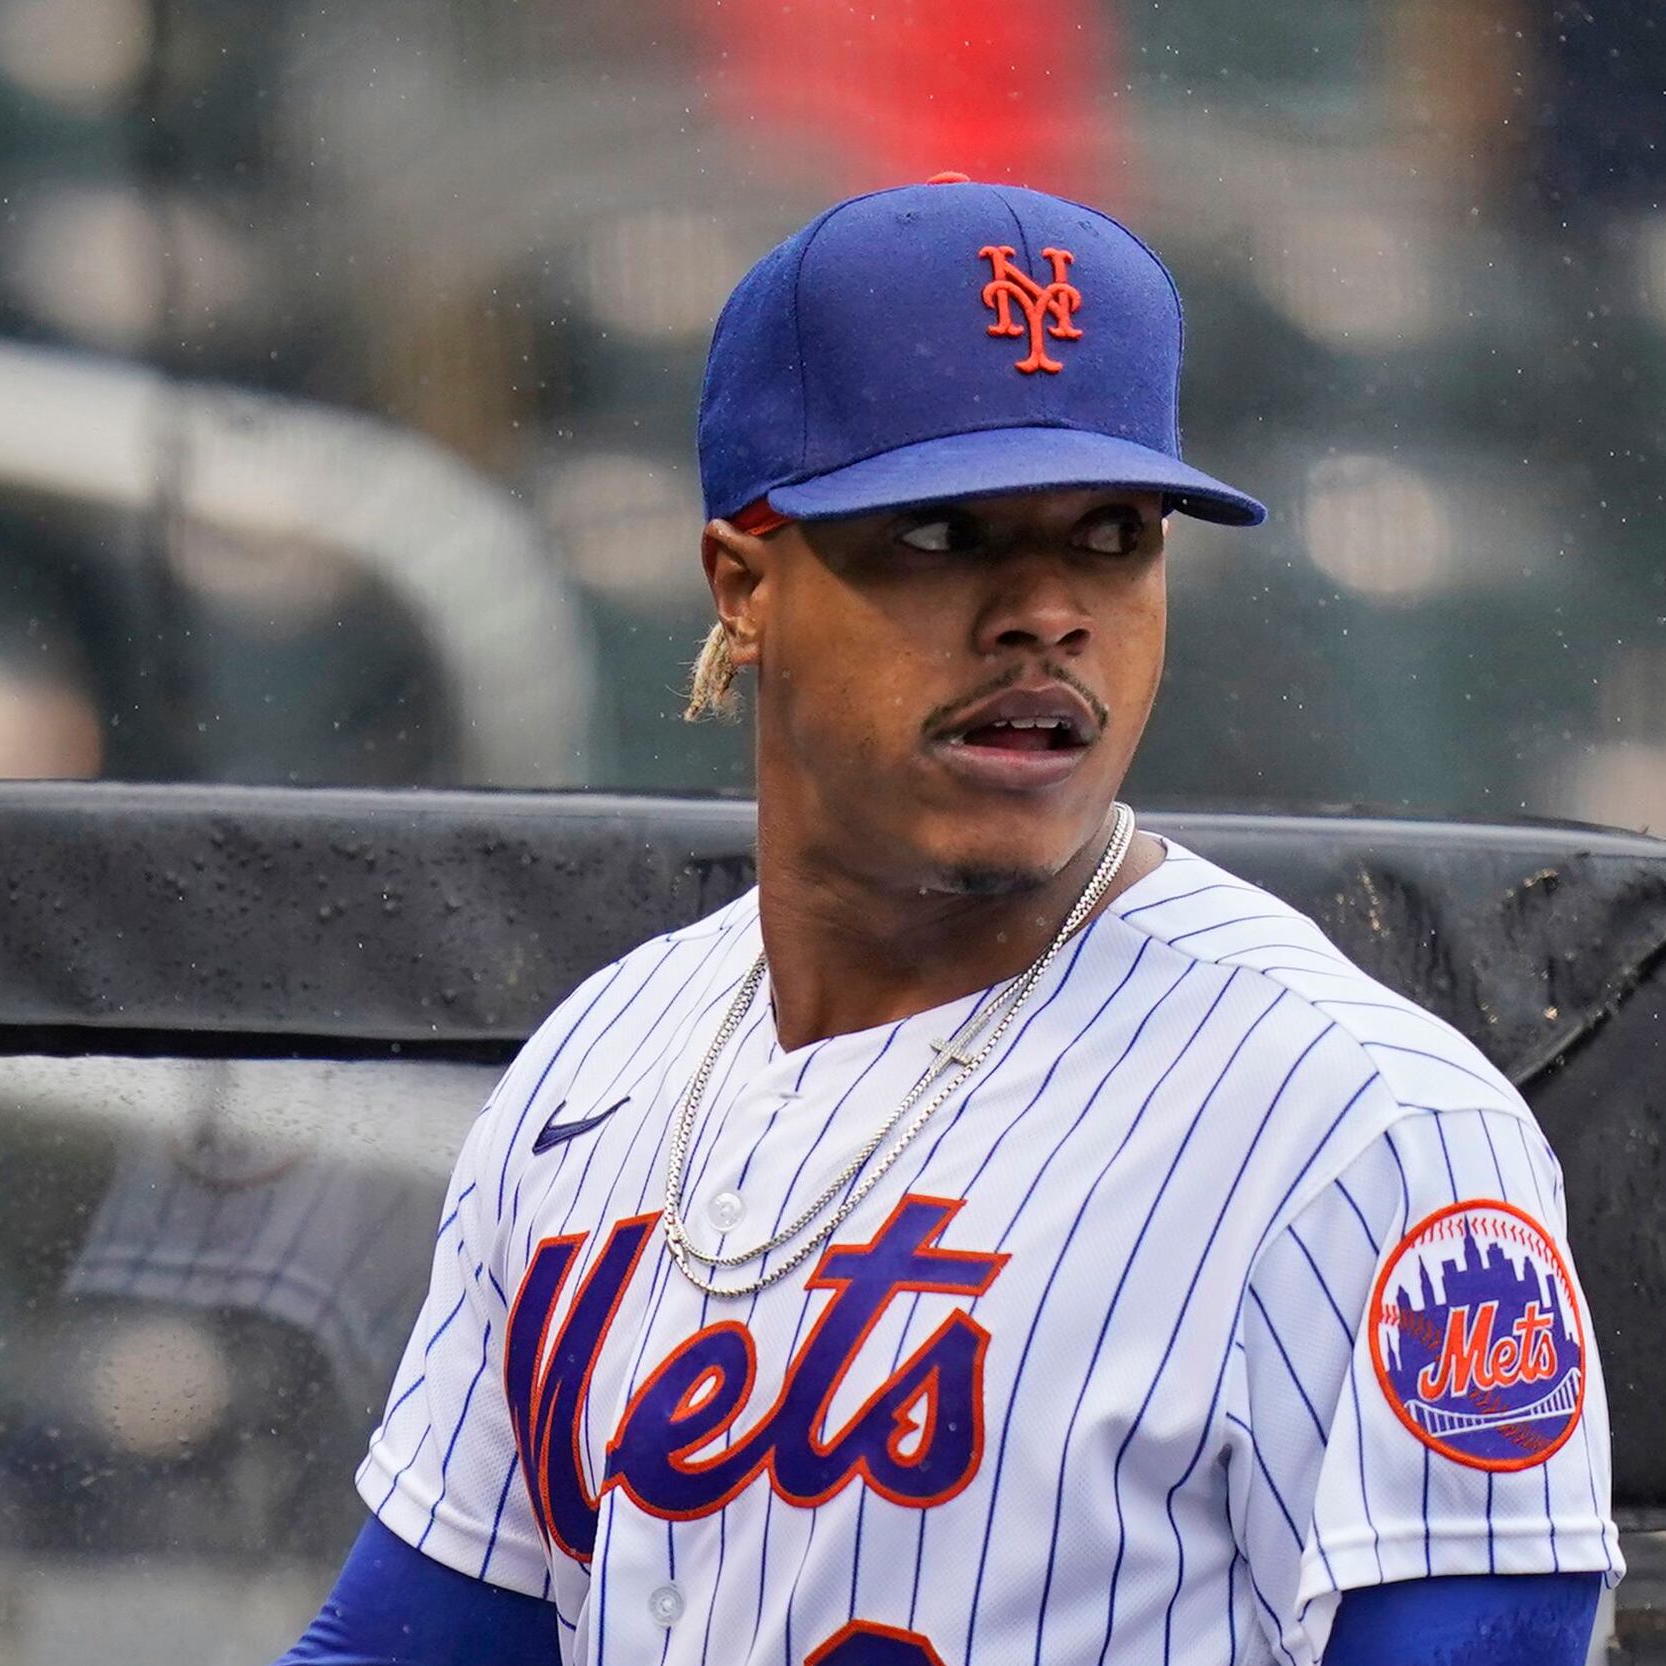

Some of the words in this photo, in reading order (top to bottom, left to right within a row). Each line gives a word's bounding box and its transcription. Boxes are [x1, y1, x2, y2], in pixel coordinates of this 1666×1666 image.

[977, 245, 1084, 375] NY
[502, 1193, 1013, 1563] Mets
[1416, 1300, 1558, 1401] Mets
